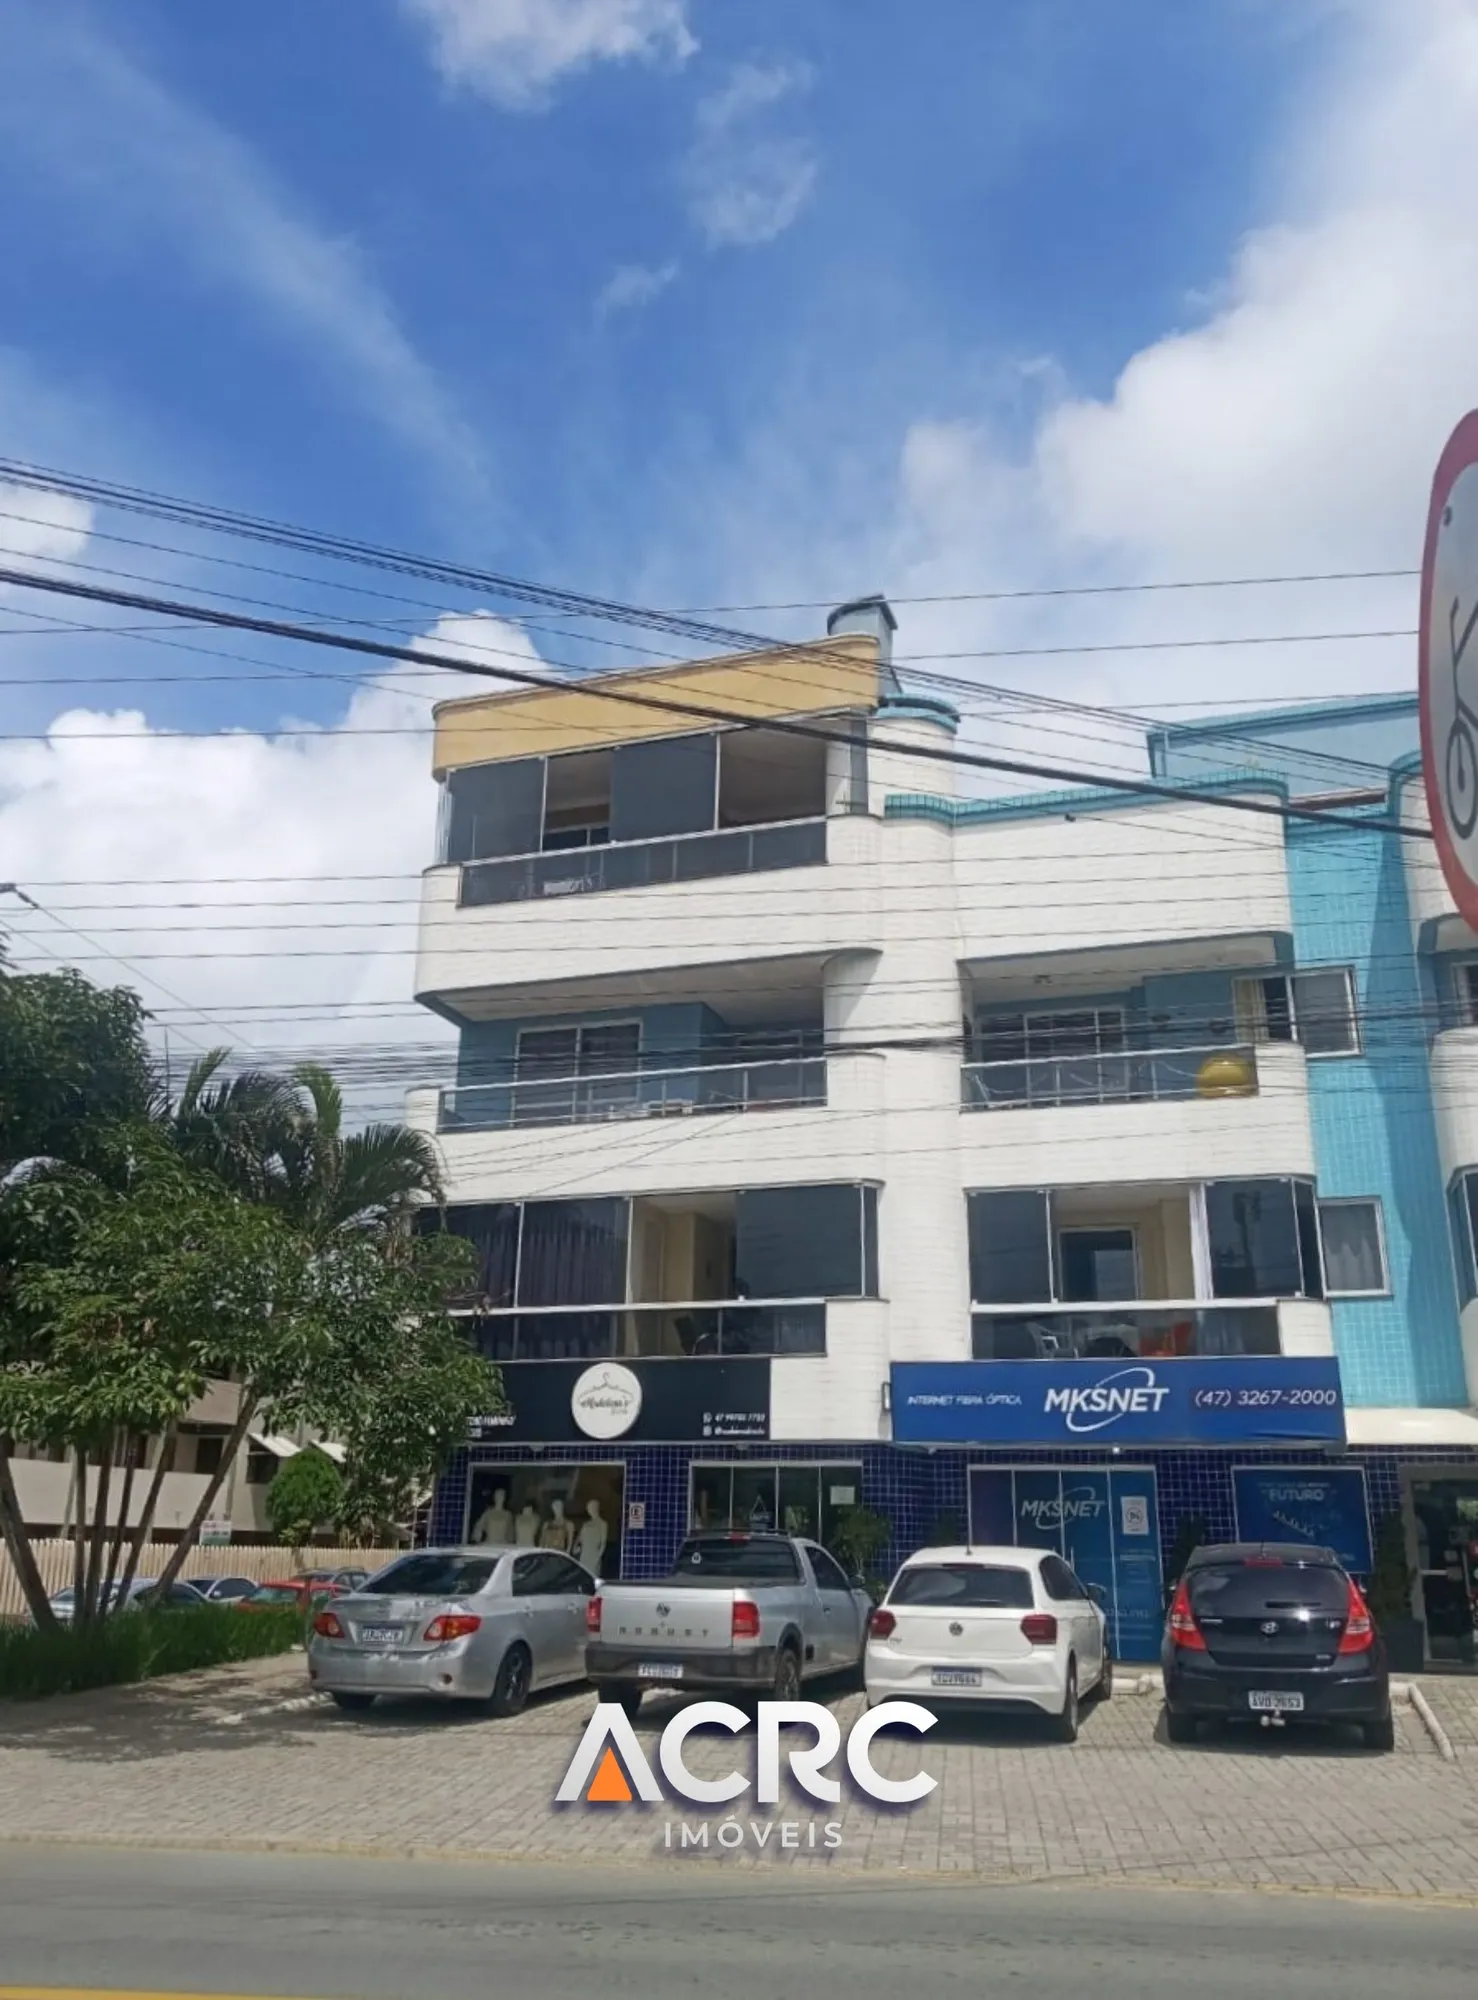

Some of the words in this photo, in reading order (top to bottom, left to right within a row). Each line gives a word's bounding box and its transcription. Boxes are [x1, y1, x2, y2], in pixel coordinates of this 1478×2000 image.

[907, 1395, 953, 1406] INTERNET
[956, 1395, 983, 1405] FIBRA
[986, 1393, 1022, 1406] ÓPTICA
[1044, 1388, 1170, 1413] MKSNET
[1195, 1389, 1232, 1407] (47)
[1238, 1389, 1337, 1405] 3267-2000
[1269, 1489, 1324, 1501] FUTURO
[1021, 1500, 1106, 1517] MKSNET
